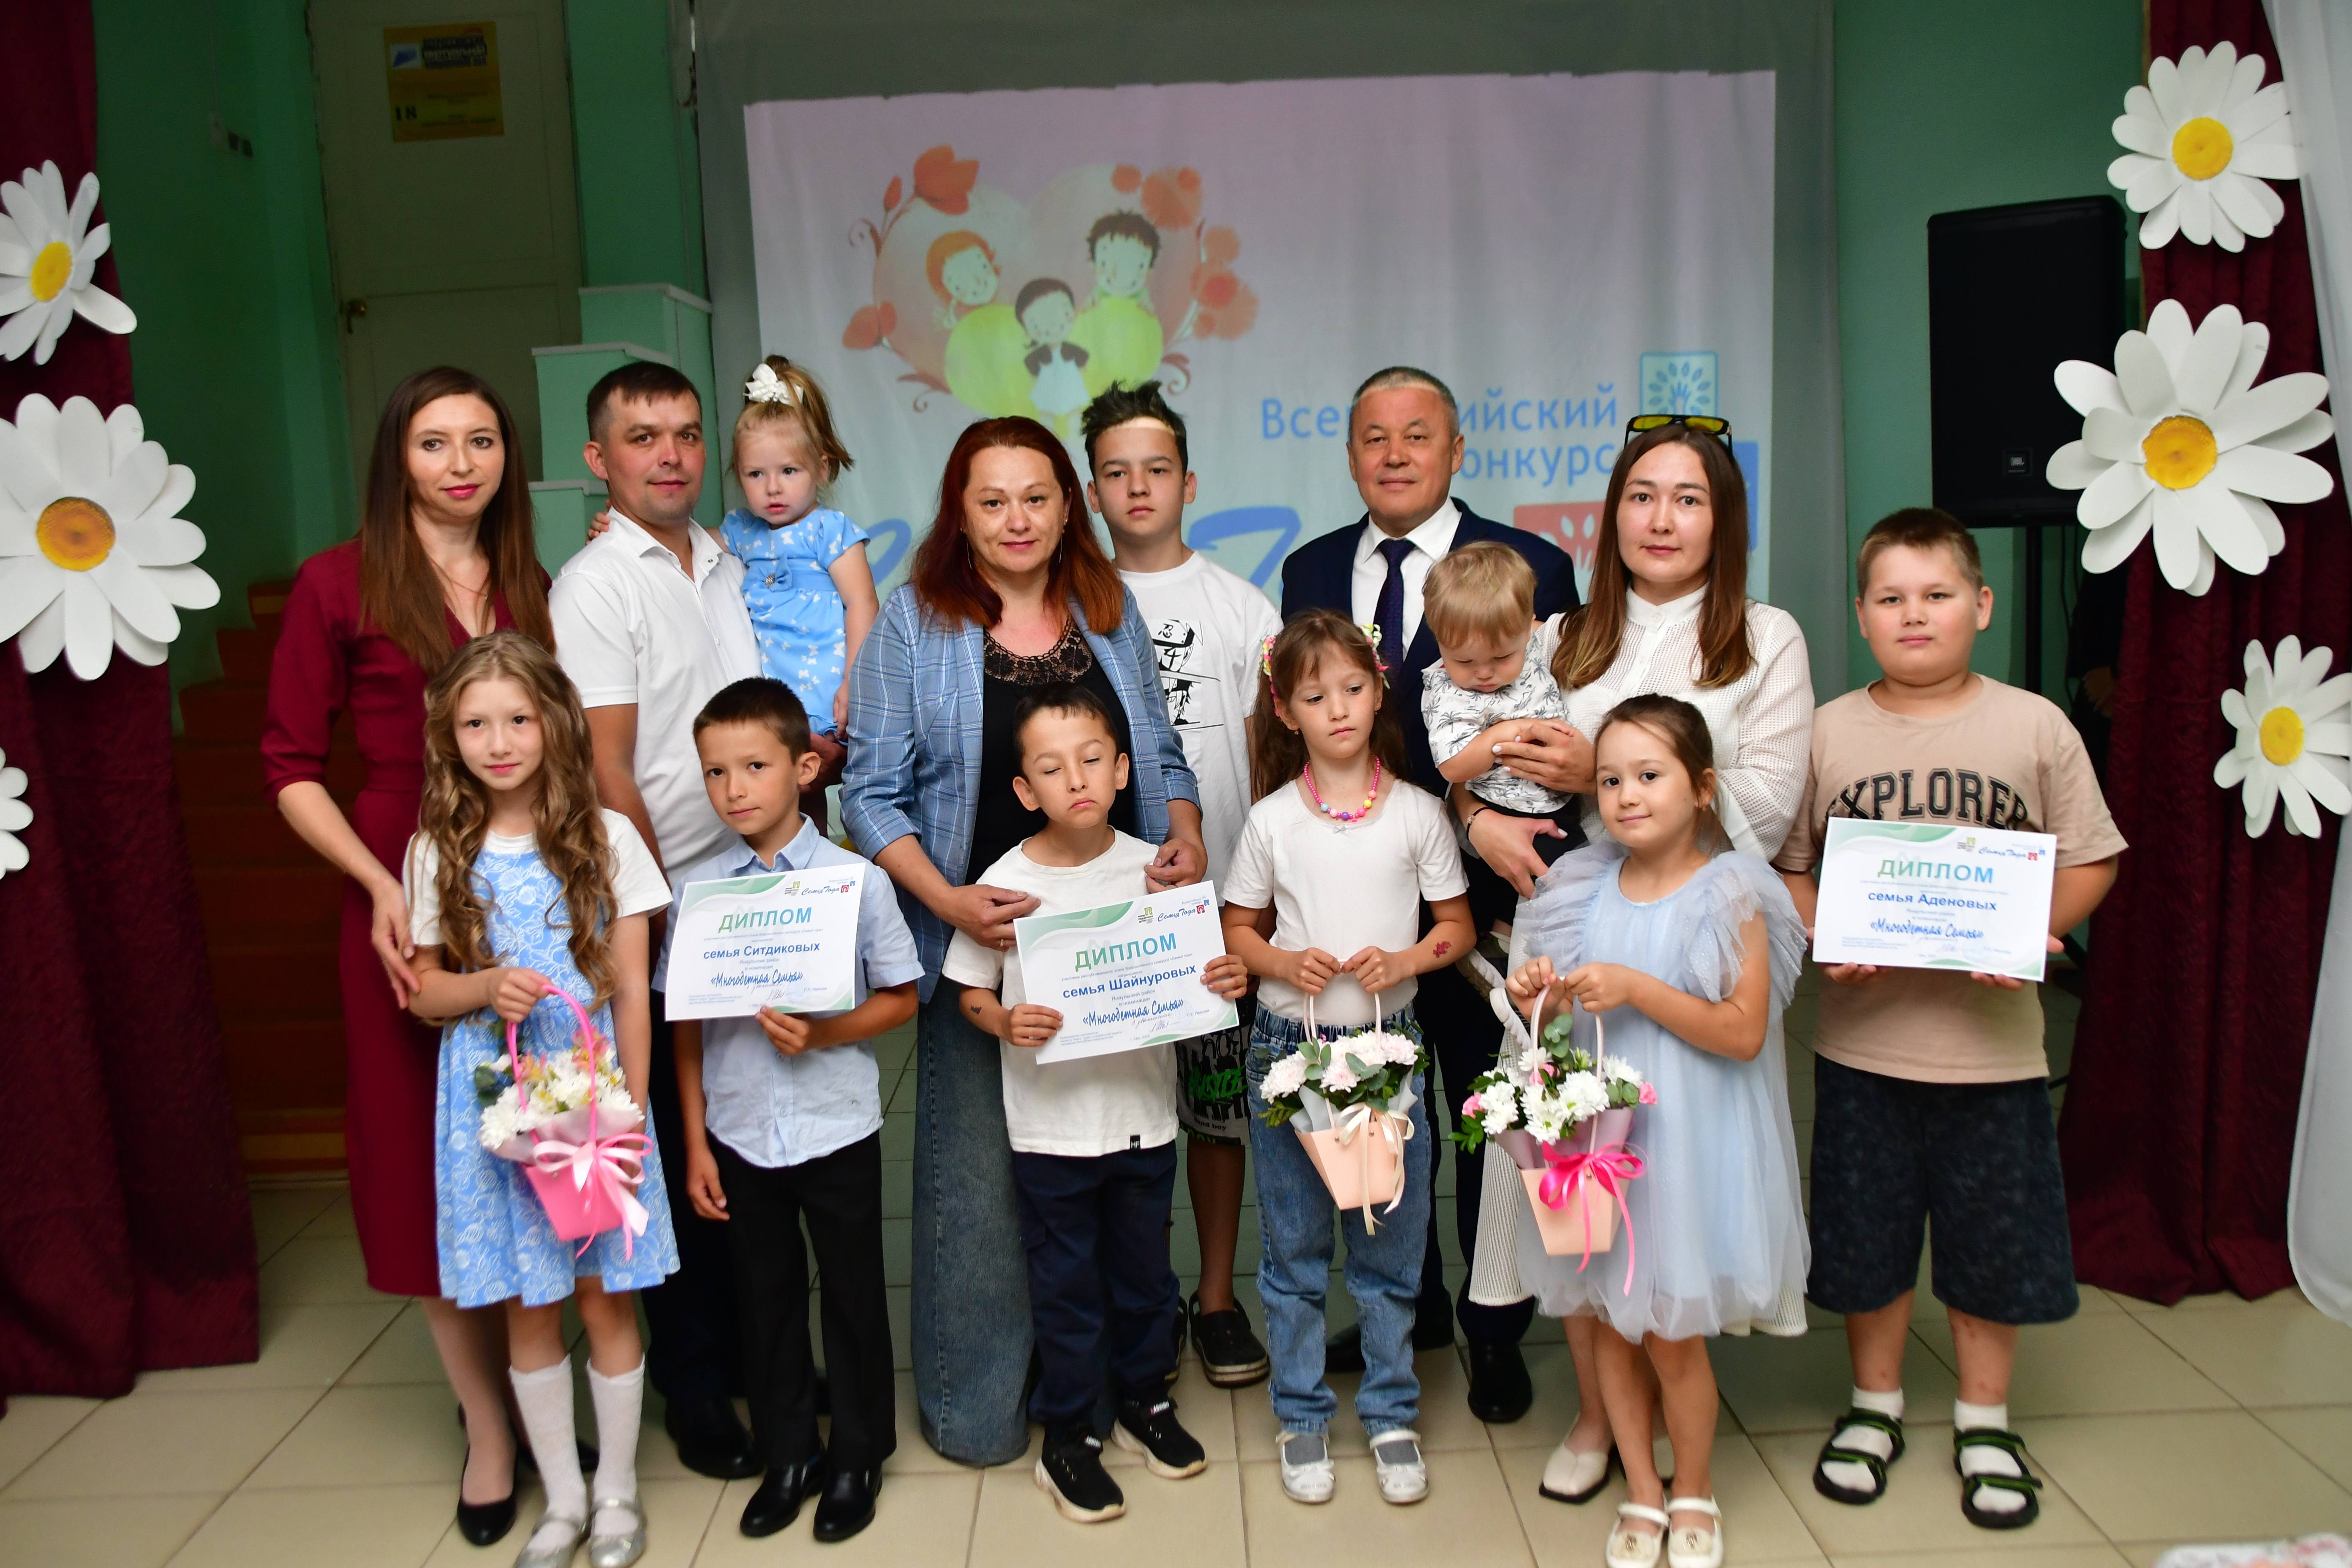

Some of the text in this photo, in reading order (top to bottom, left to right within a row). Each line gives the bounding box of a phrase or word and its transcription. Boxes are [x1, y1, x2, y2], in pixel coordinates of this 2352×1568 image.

[1453, 444, 1615, 487] онкурс
[1878, 860, 1993, 883] ДИПЛОМ
[1868, 893, 1996, 910] семья Аденовых
[718, 907, 812, 934] ДИПЛОМ
[703, 943, 820, 959] семья Ситдиковых
[1075, 933, 1176, 972] ДИПЛОМ
[1063, 965, 1196, 998] семья Шайнуровых
[1083, 999, 1184, 1026] «Многодетная Семья»
